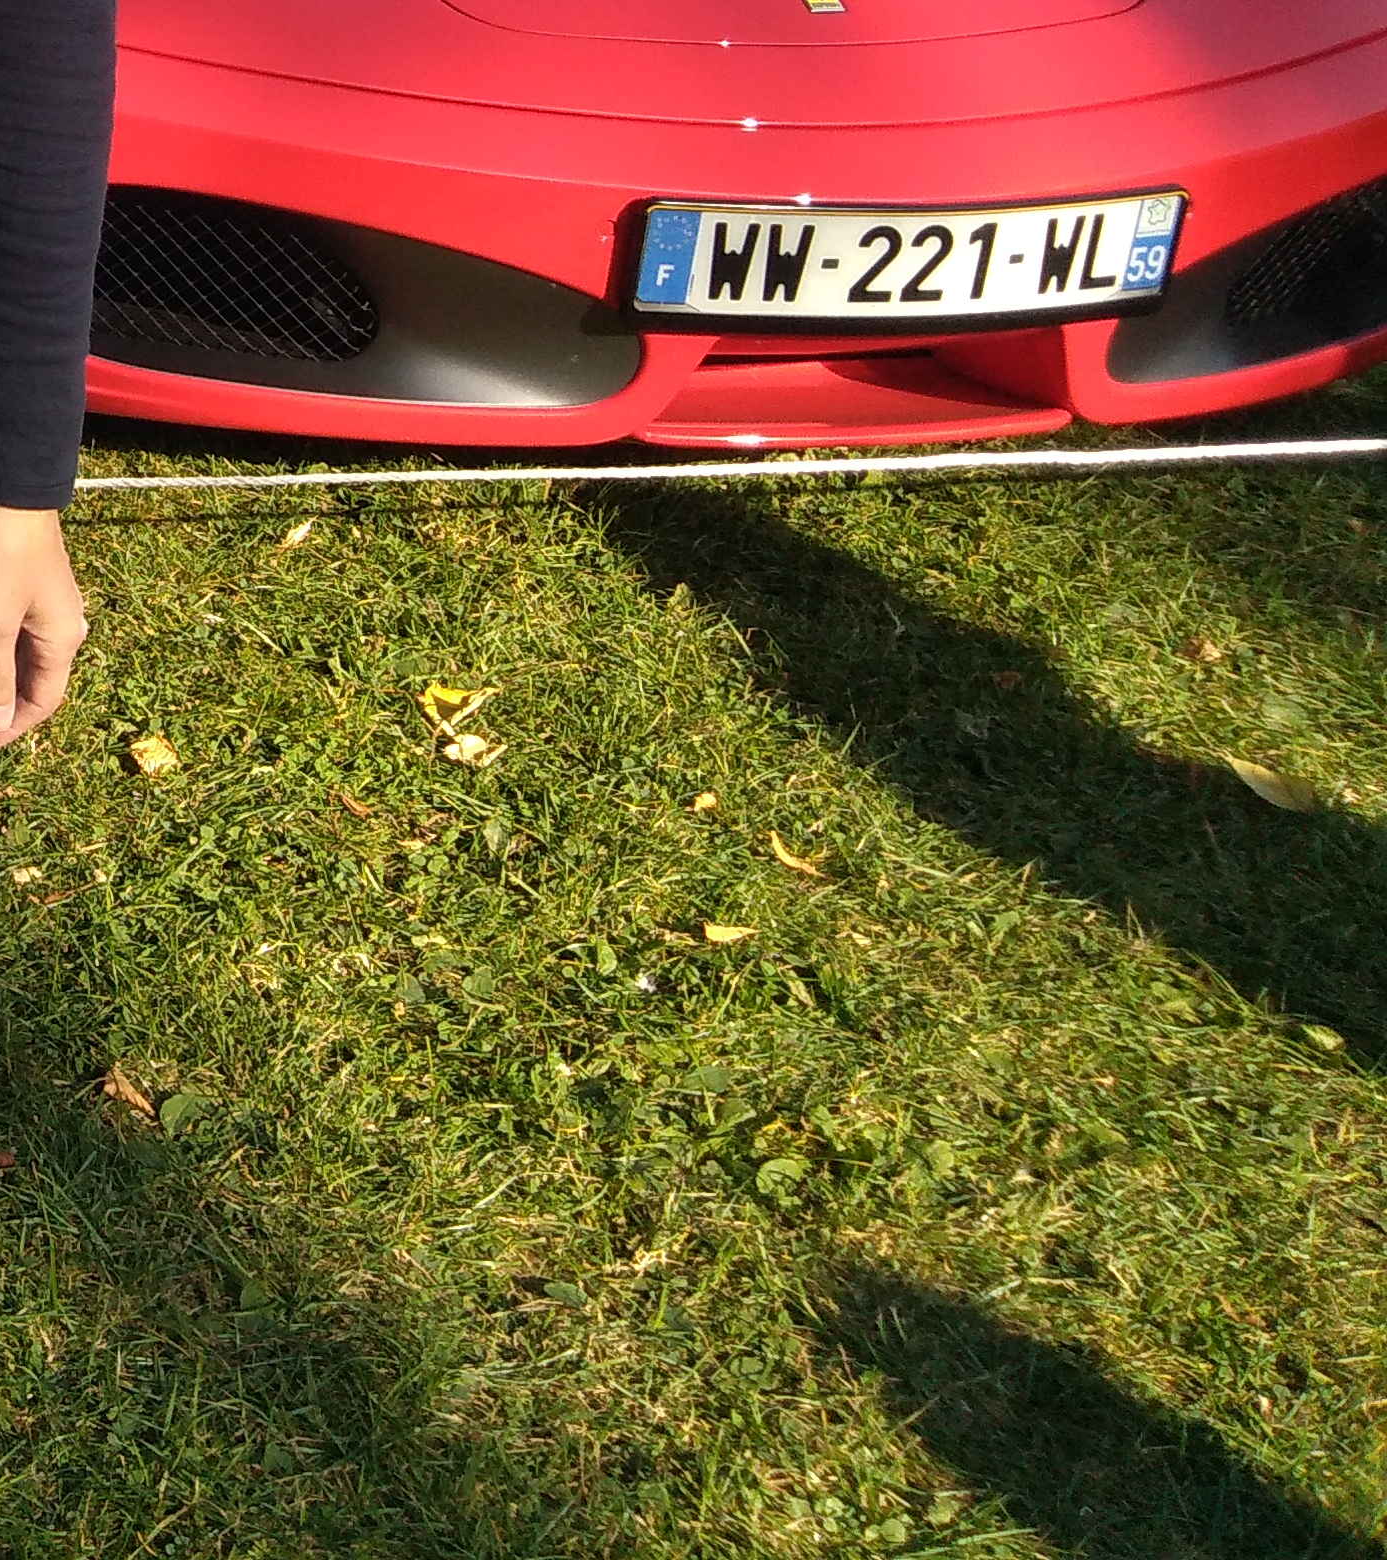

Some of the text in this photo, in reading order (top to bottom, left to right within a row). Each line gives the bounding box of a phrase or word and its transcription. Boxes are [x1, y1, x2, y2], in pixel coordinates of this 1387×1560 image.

[655, 212, 1167, 304] F WW-221-WL 59
